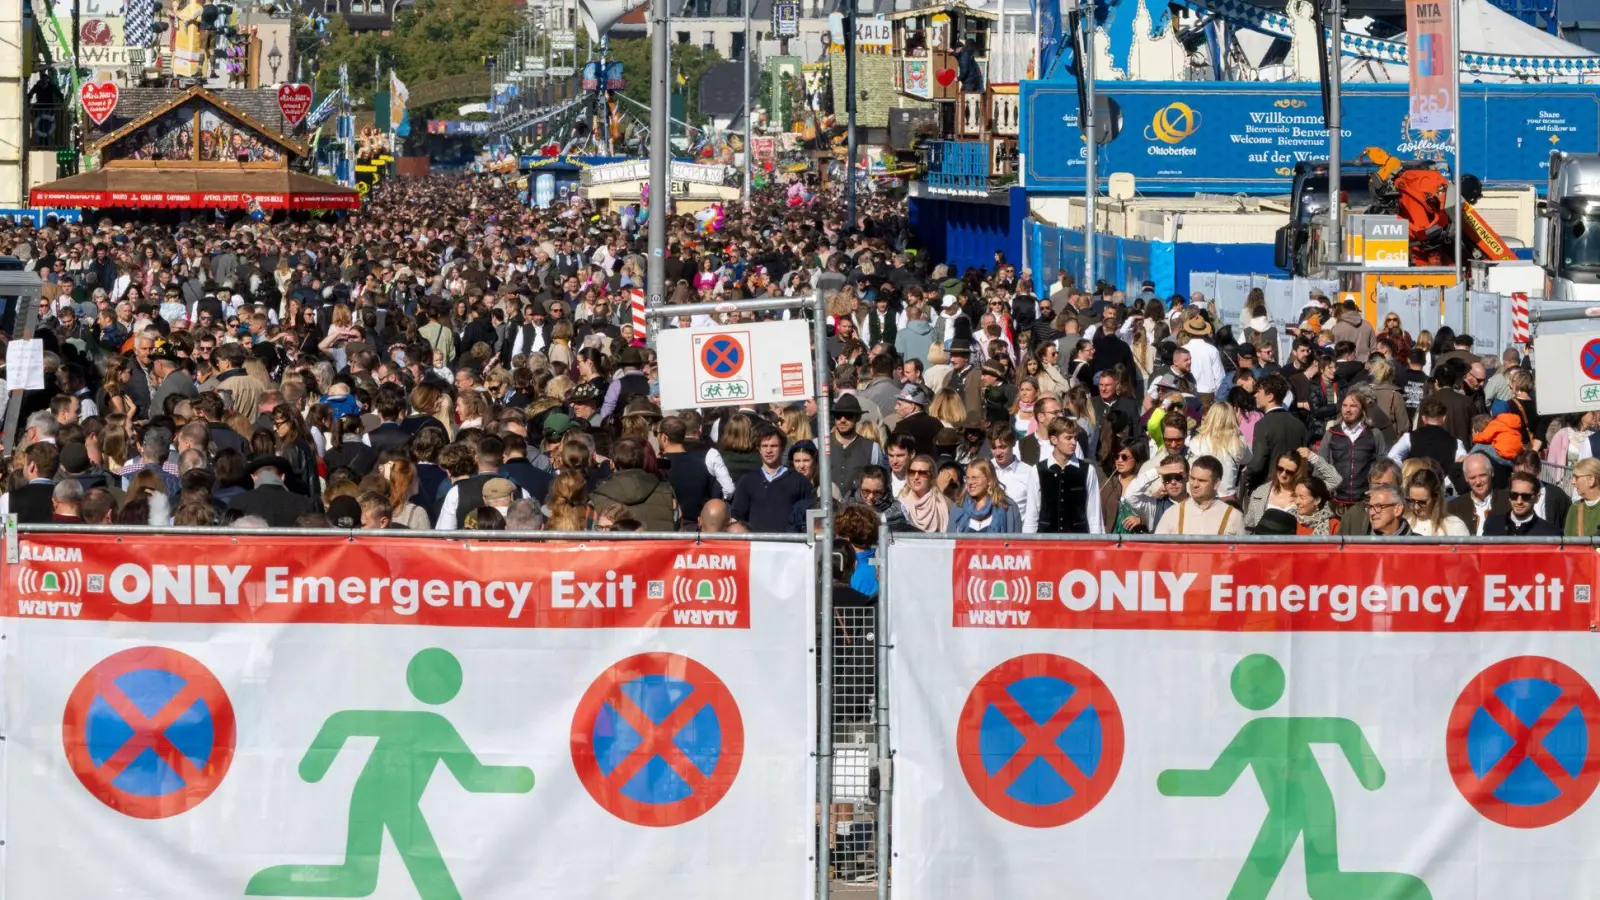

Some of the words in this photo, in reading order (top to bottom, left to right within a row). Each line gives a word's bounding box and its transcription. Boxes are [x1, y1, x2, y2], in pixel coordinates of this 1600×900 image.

[82, 48, 128, 62] Wirt
[1249, 112, 1325, 124] Willkomme
[1246, 125, 1290, 133] Bienvenido
[1292, 127, 1352, 137] Benveto
[1230, 134, 1273, 144] Welcome
[1278, 136, 1325, 146] Bienvenue
[1147, 146, 1197, 156] Oktoberfest
[1248, 151, 1270, 162] auf
[1271, 151, 1291, 162] der
[1371, 224, 1403, 236] ATM
[1466, 214, 1502, 254] PALFINGER
[1376, 248, 1408, 262] Cash
[19, 546, 83, 563] ALARM
[674, 554, 737, 570] ALARM
[968, 554, 1032, 570] ALARM
[109, 563, 252, 605] ONLY
[265, 566, 533, 619] Emergency
[550, 569, 637, 609] Exit
[1058, 569, 1199, 612] ONLY
[1210, 574, 1468, 623] Emergency
[1483, 573, 1565, 612] Exit
[18, 600, 83, 617] ALARM
[673, 609, 738, 625] ALARM
[968, 609, 1031, 626] ALARM
